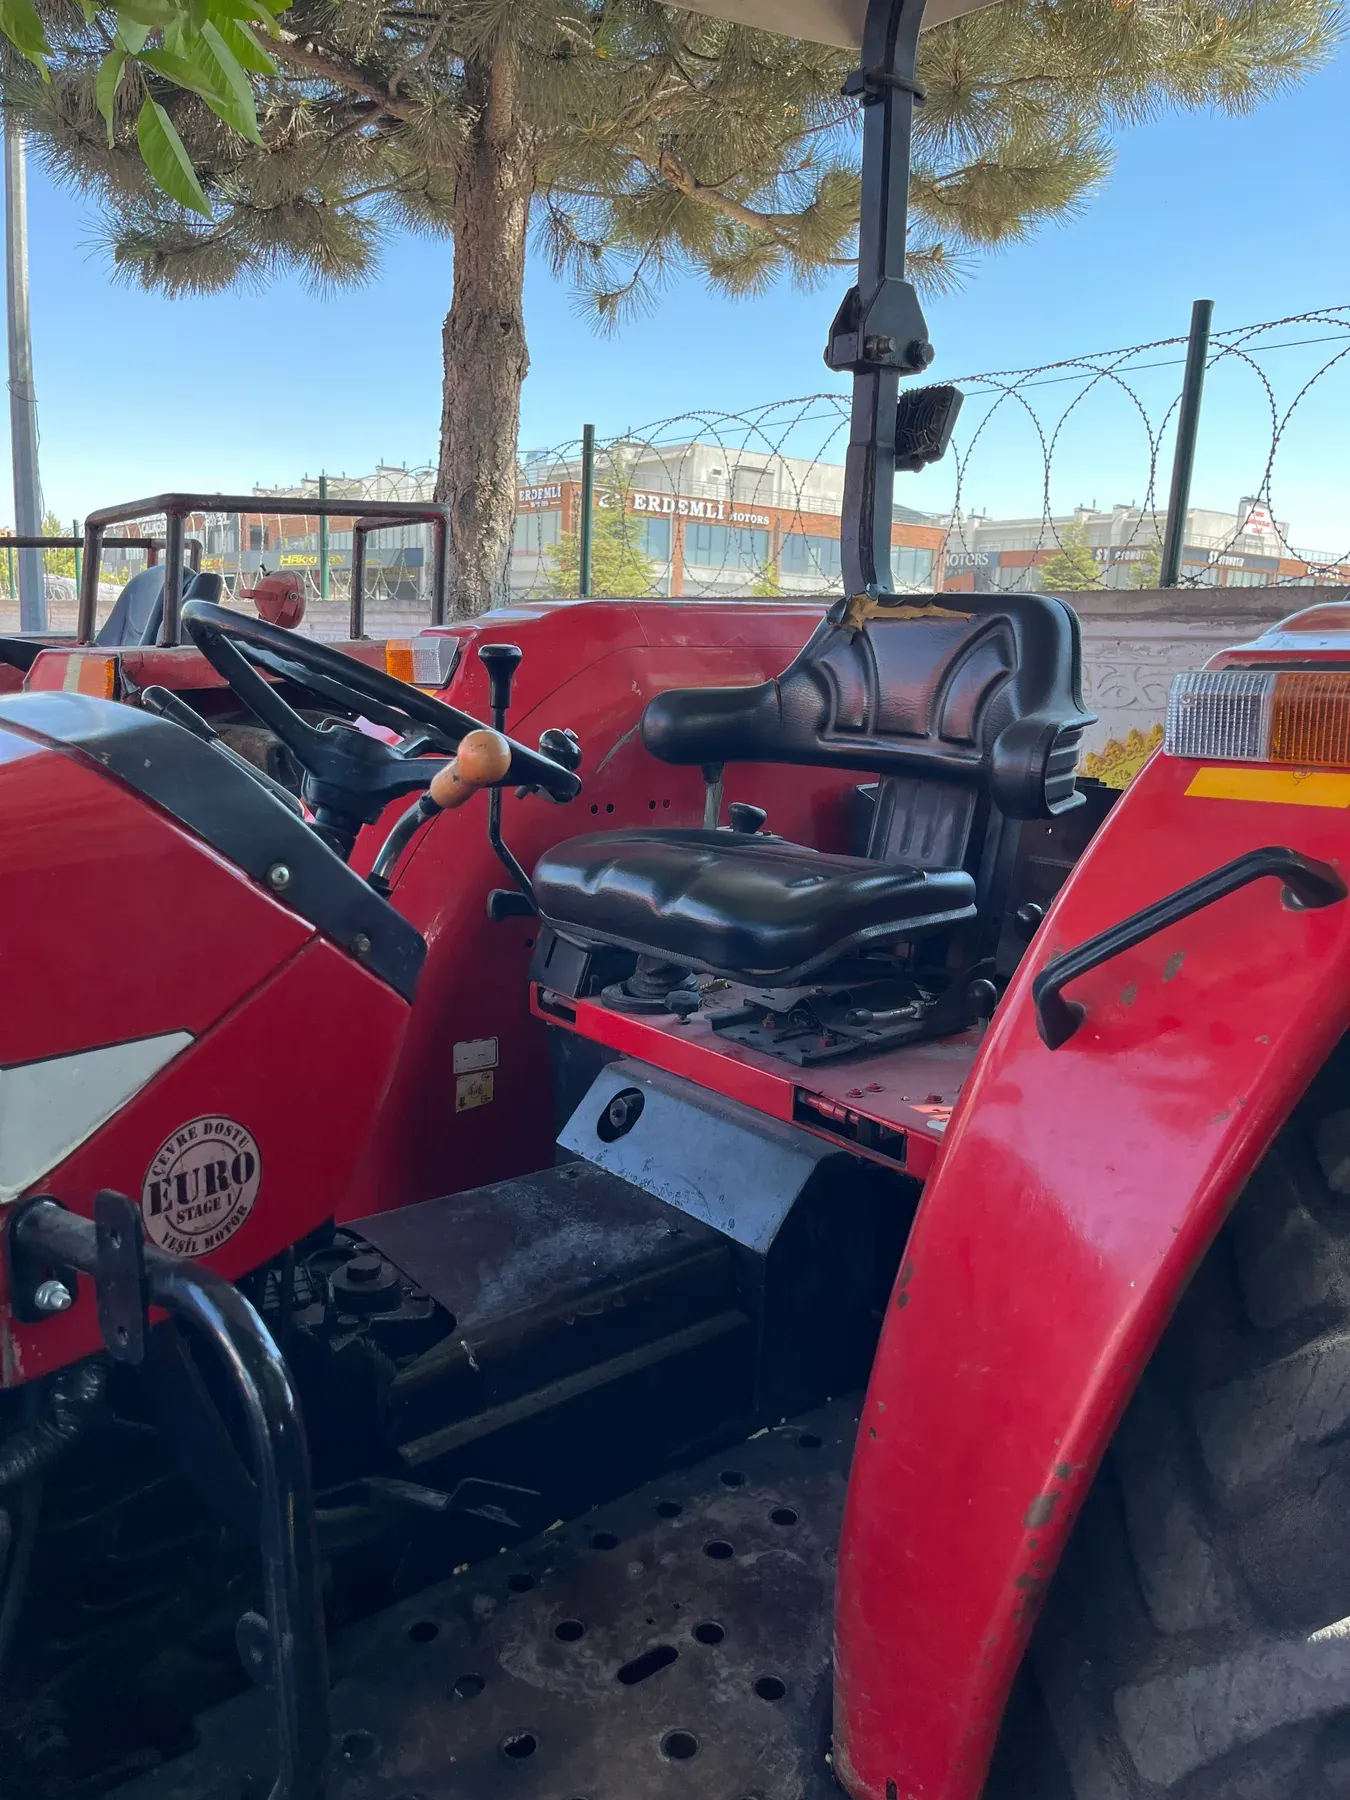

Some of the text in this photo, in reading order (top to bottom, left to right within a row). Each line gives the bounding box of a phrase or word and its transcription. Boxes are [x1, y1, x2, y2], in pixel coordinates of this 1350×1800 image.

[518, 482, 562, 501] ERDEMLİ
[633, 493, 771, 526] ERDEMLİ MOTORS
[203, 1122, 251, 1149] DOSTU
[147, 1151, 256, 1217] EURO
[176, 1196, 222, 1225] STAGE
[161, 1204, 248, 1255] YEŞİL MOTOR
